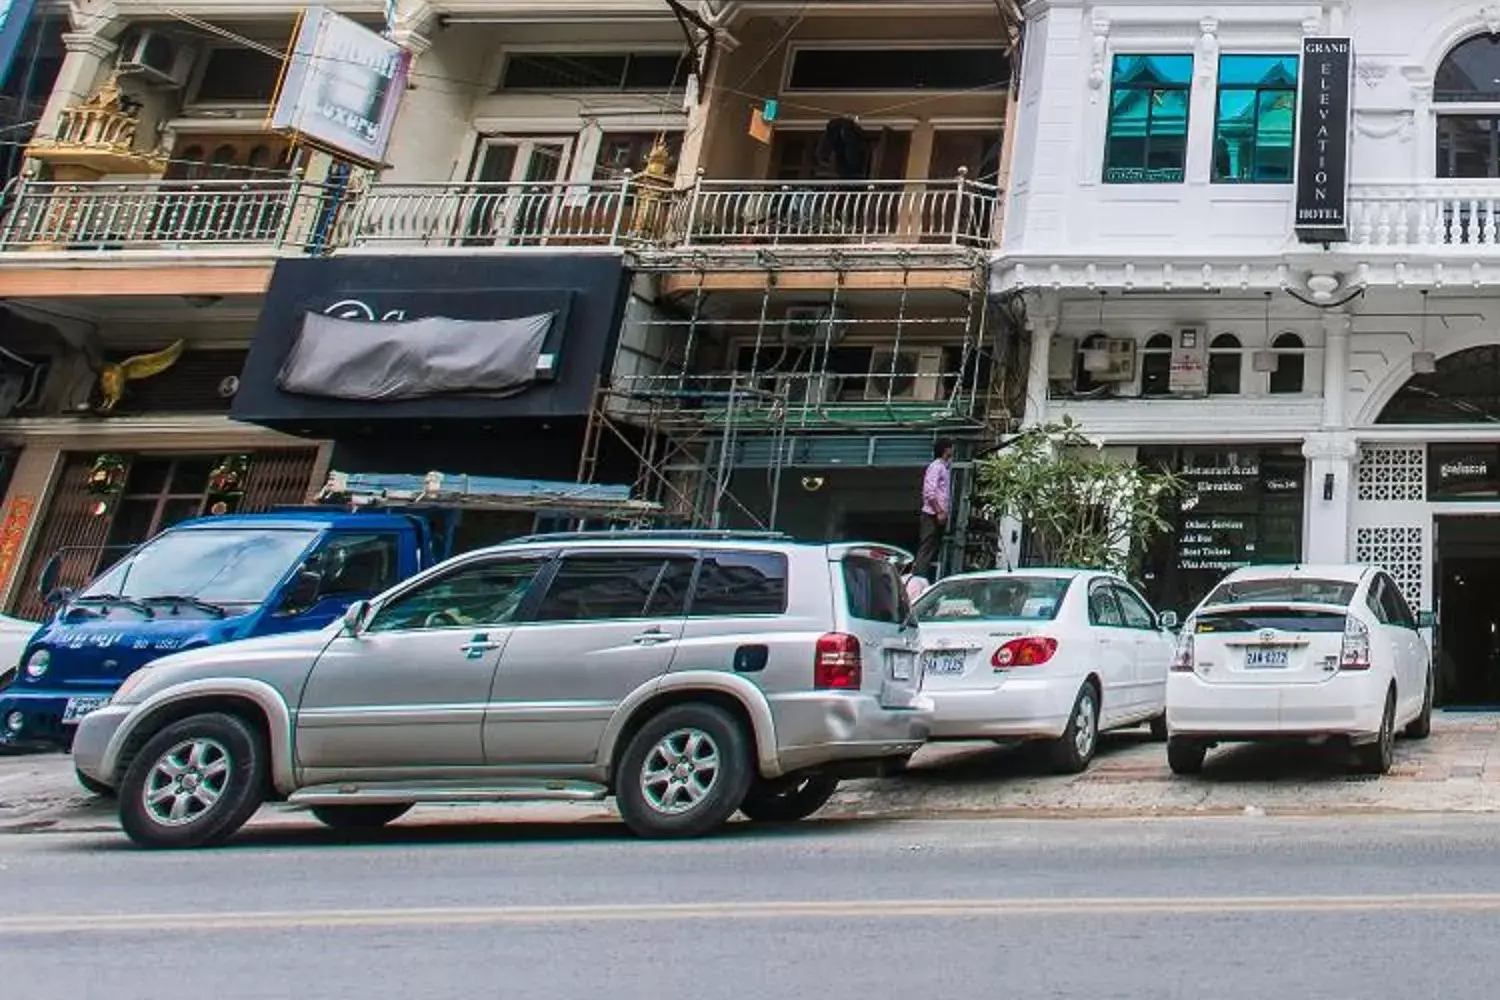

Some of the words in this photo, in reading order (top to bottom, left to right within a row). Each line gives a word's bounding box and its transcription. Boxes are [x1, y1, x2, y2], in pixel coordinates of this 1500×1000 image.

[1305, 42, 1347, 54] GRAND
[1315, 63, 1330, 200] ELEVATION
[1299, 208, 1342, 219] HOTEL
[1197, 481, 1243, 491] Elevation
